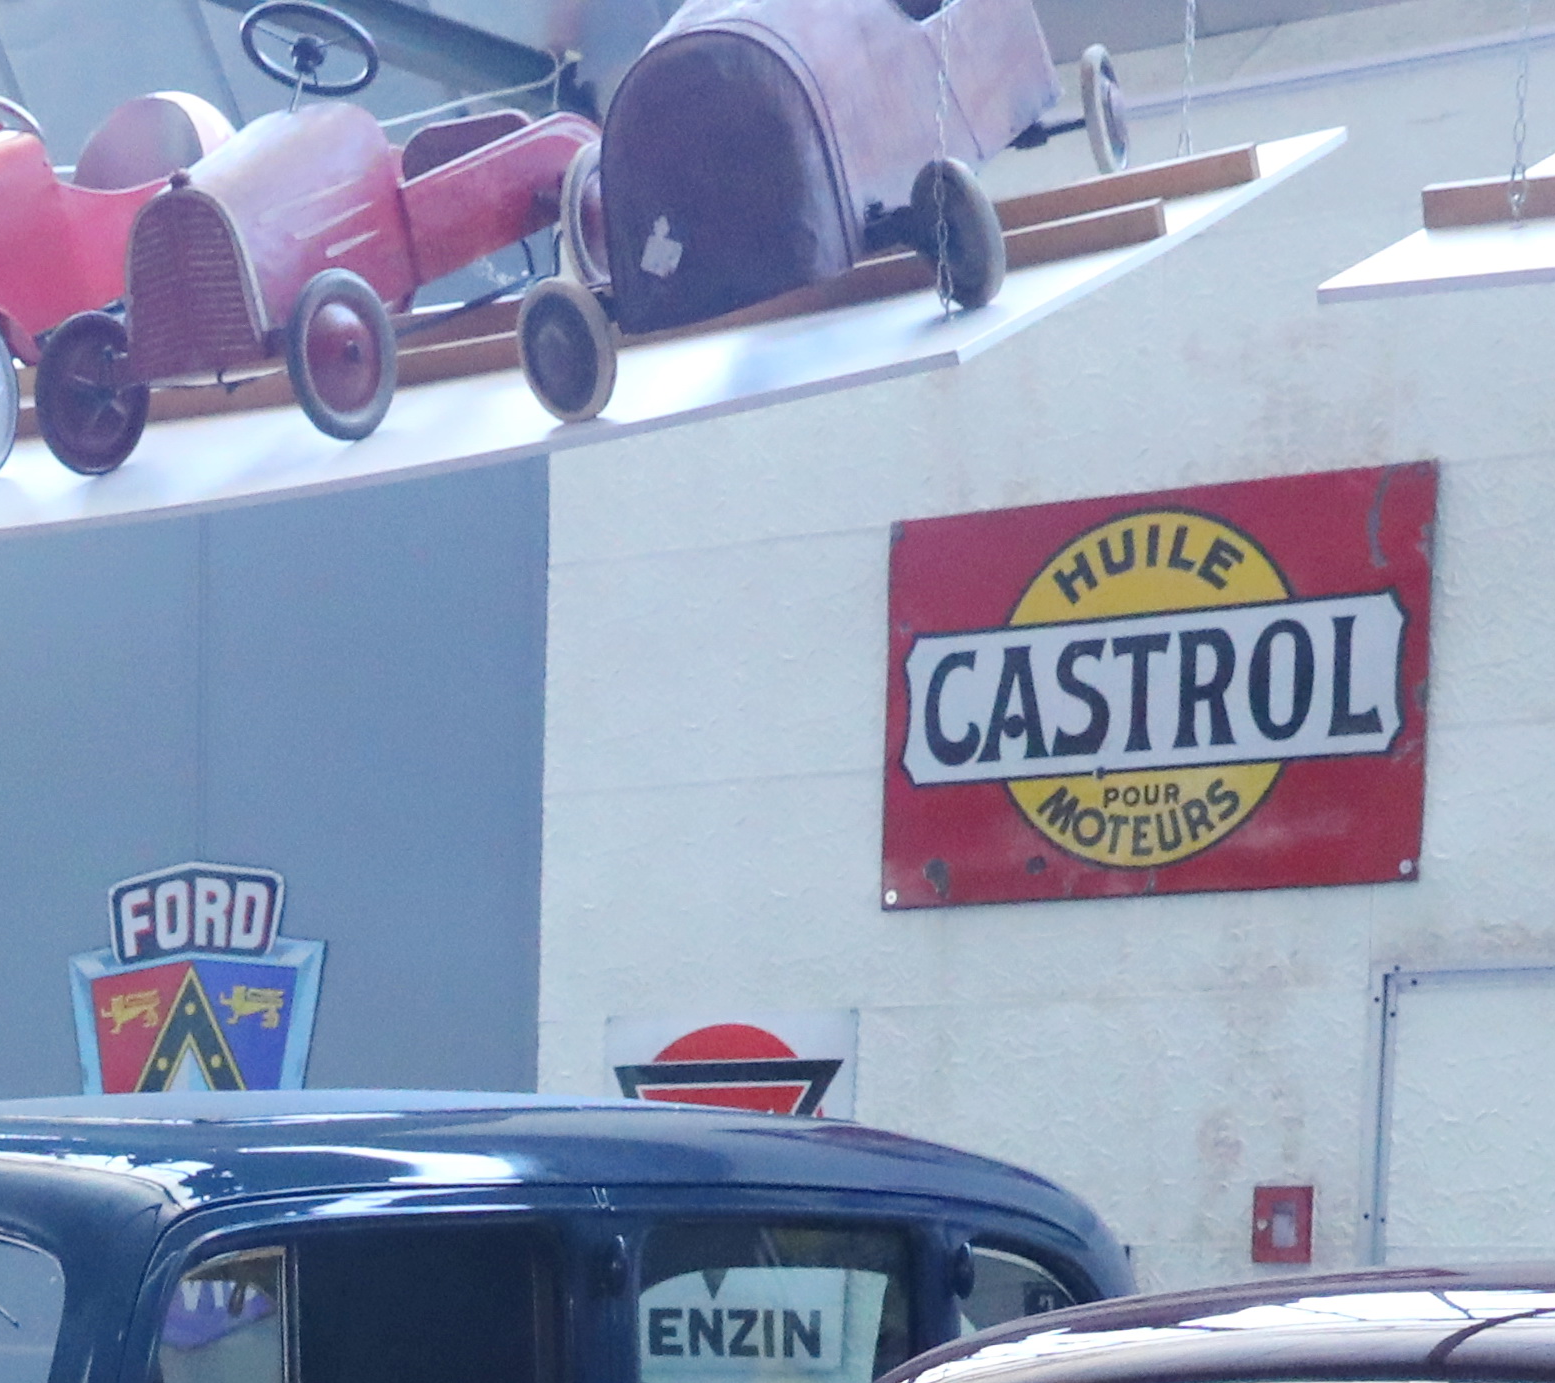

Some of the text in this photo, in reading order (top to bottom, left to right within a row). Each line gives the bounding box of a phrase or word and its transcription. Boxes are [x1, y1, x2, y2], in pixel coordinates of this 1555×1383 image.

[1053, 525, 1244, 604] HUILE
[923, 614, 1384, 767] CASTROL
[1036, 778, 1242, 857] MOTEURS
[1102, 784, 1181, 808] POUR
[120, 876, 269, 958] FORD
